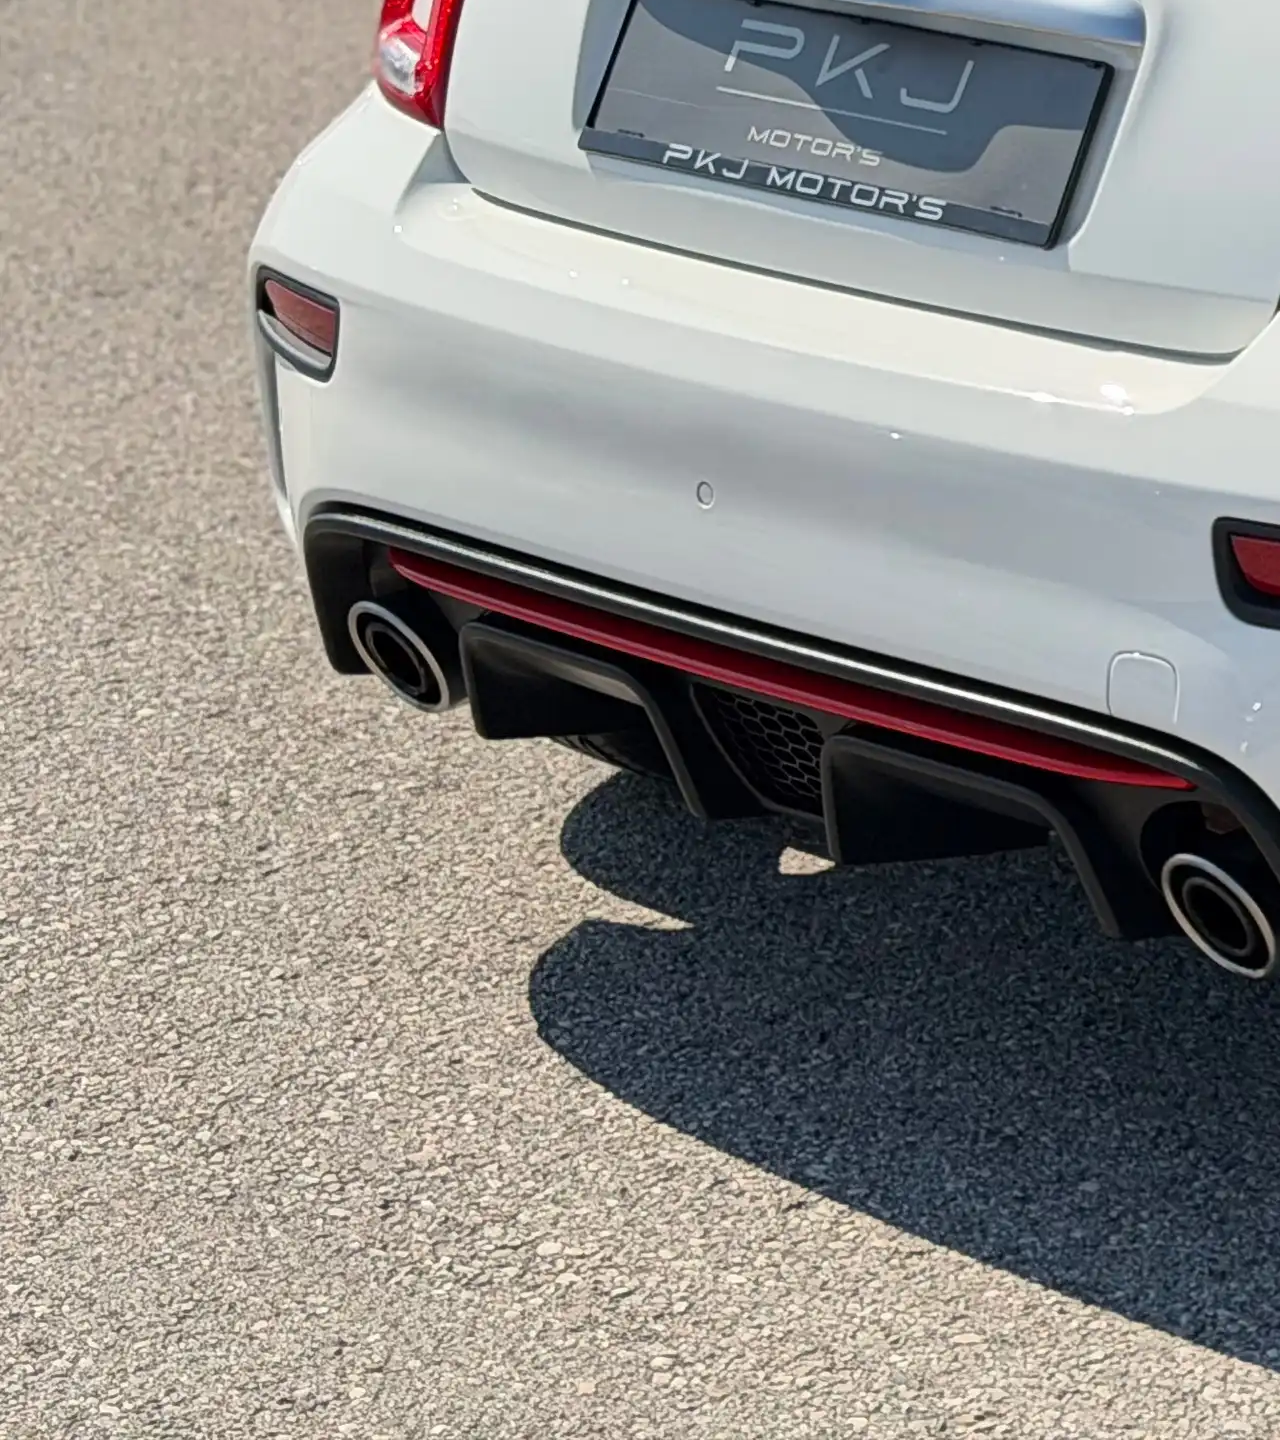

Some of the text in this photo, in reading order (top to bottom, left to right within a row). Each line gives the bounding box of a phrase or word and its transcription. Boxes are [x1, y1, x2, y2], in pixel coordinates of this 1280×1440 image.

[723, 18, 975, 113] PKJ
[662, 142, 948, 222] PKJ MOTOR'S
[746, 125, 883, 167] MOTOR'S
